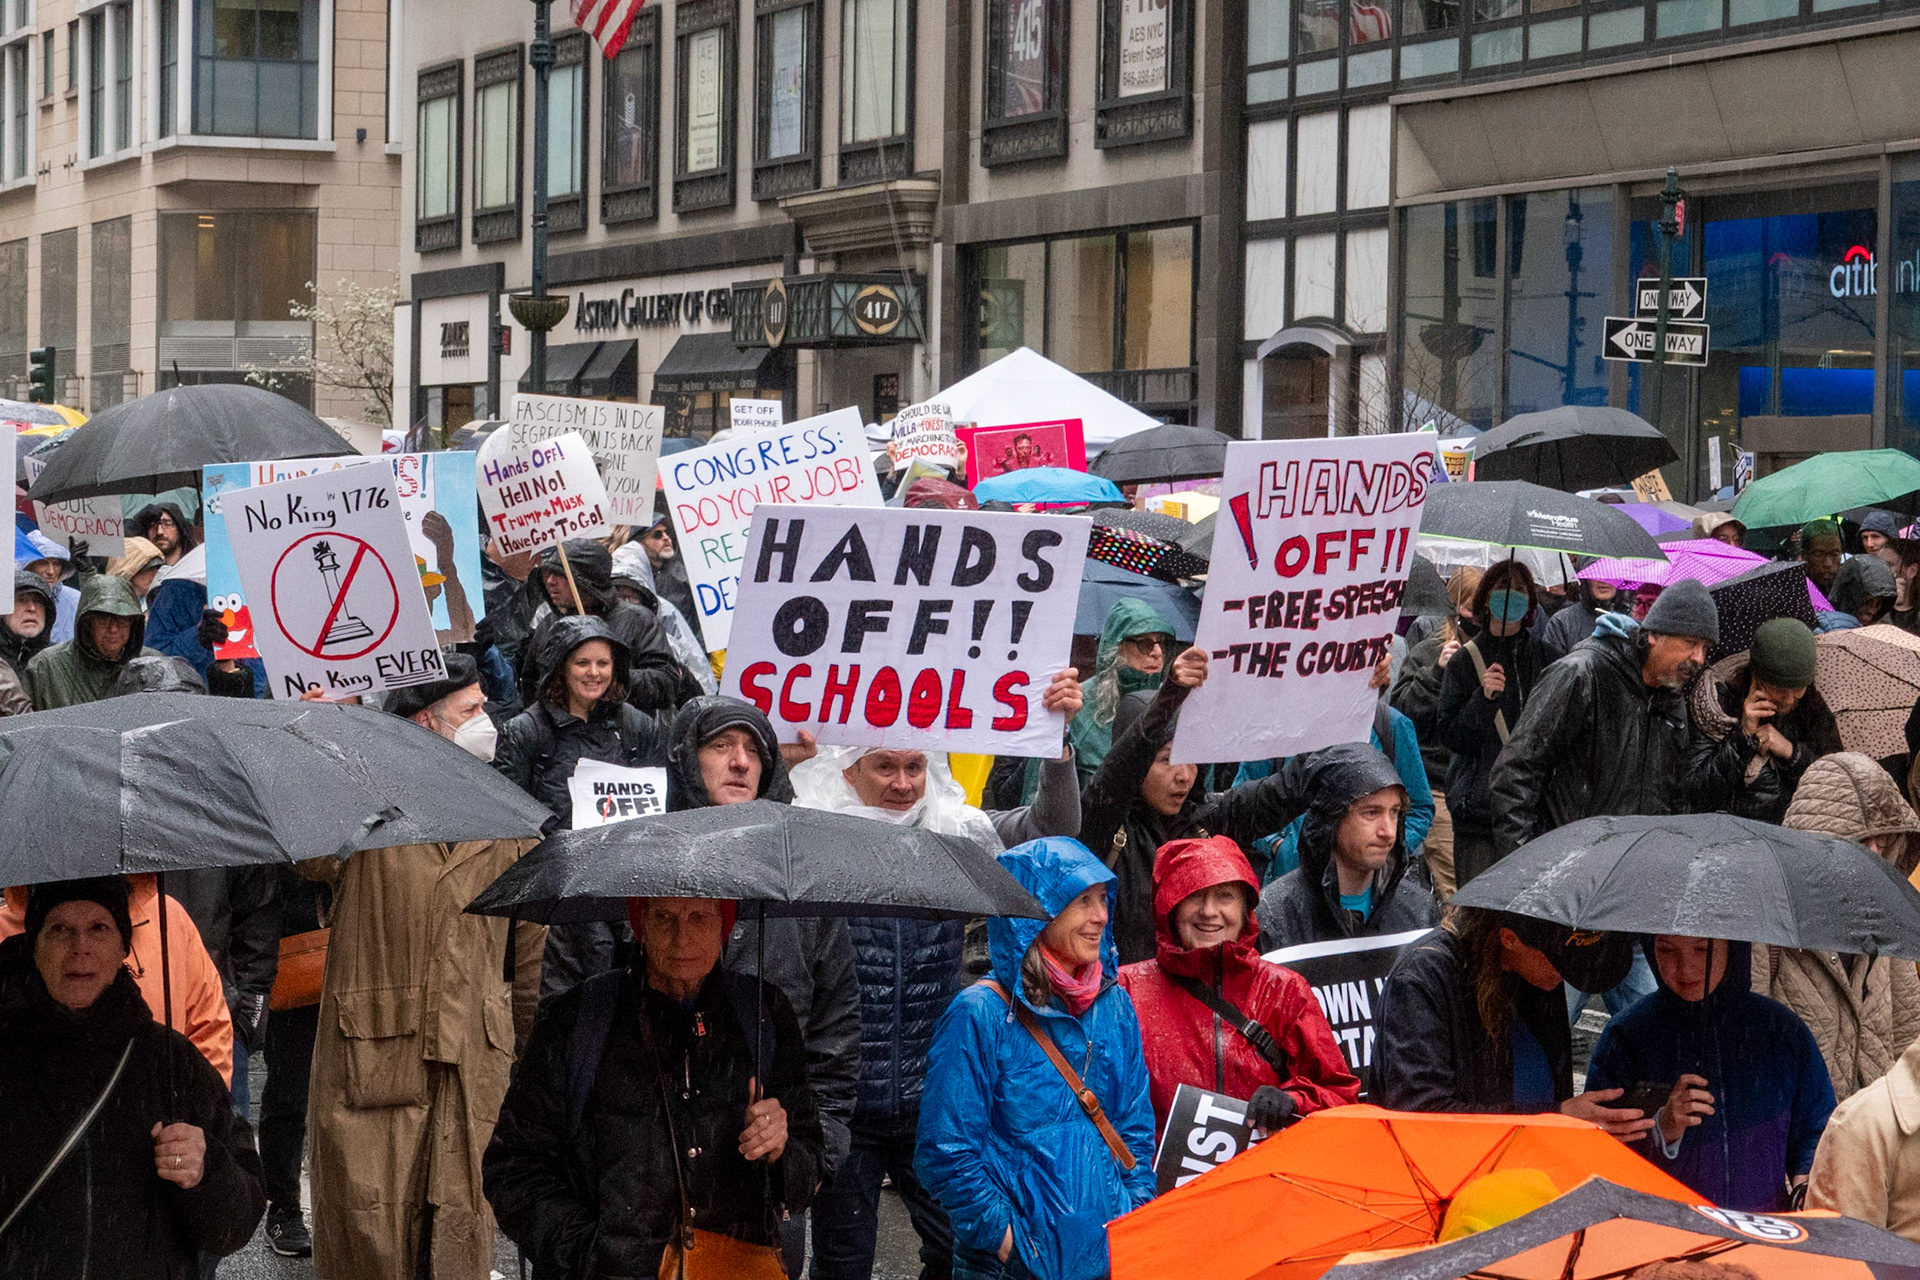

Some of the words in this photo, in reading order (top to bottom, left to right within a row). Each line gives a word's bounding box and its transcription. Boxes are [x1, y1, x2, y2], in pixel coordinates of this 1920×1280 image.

[1014, 0, 1042, 62] 415
[1129, 27, 1145, 42] AES
[1147, 22, 1163, 39] NYC
[1122, 48, 1144, 64] Event
[1146, 45, 1165, 62] Spac
[620, 288, 683, 327] GALLERY
[684, 290, 704, 322] OF
[863, 301, 891, 319] 417
[1671, 292, 1692, 307] WAY
[1624, 332, 1653, 348] ONE
[1666, 335, 1697, 352] WAY
[516, 400, 587, 425] FASCISM
[592, 405, 608, 426] IS
[615, 407, 628, 429] IN
[733, 418, 752, 427] YOUR
[754, 419, 779, 428] PHONE
[734, 405, 753, 414] GET
[756, 406, 774, 415] OFF
[900, 404, 930, 423] SHOULD
[931, 404, 941, 415] BE
[603, 431, 617, 450] IS
[621, 432, 654, 452] BACK
[674, 426, 843, 491] CONGRESS:
[532, 469, 567, 499] No!
[614, 476, 640, 494] YOU
[677, 498, 720, 534] DO
[800, 456, 865, 501] JOB!
[1256, 451, 1434, 520] HANDS
[43, 506, 122, 537] DEMOCRACY
[245, 499, 282, 533] No
[287, 493, 337, 529] King
[342, 487, 390, 514] 1776
[577, 504, 605, 529] Go!
[753, 517, 1064, 593] HANDS
[1273, 526, 1411, 579] OFF!!
[1322, 578, 1408, 622] SPEECH
[772, 595, 1034, 661] OFF!!
[1295, 632, 1394, 678] COURTS
[325, 669, 373, 694] King
[375, 648, 443, 678] EVER!
[739, 661, 1031, 732] SCHOOLS
[593, 781, 656, 796] HANDS
[596, 796, 662, 818] OFF!
